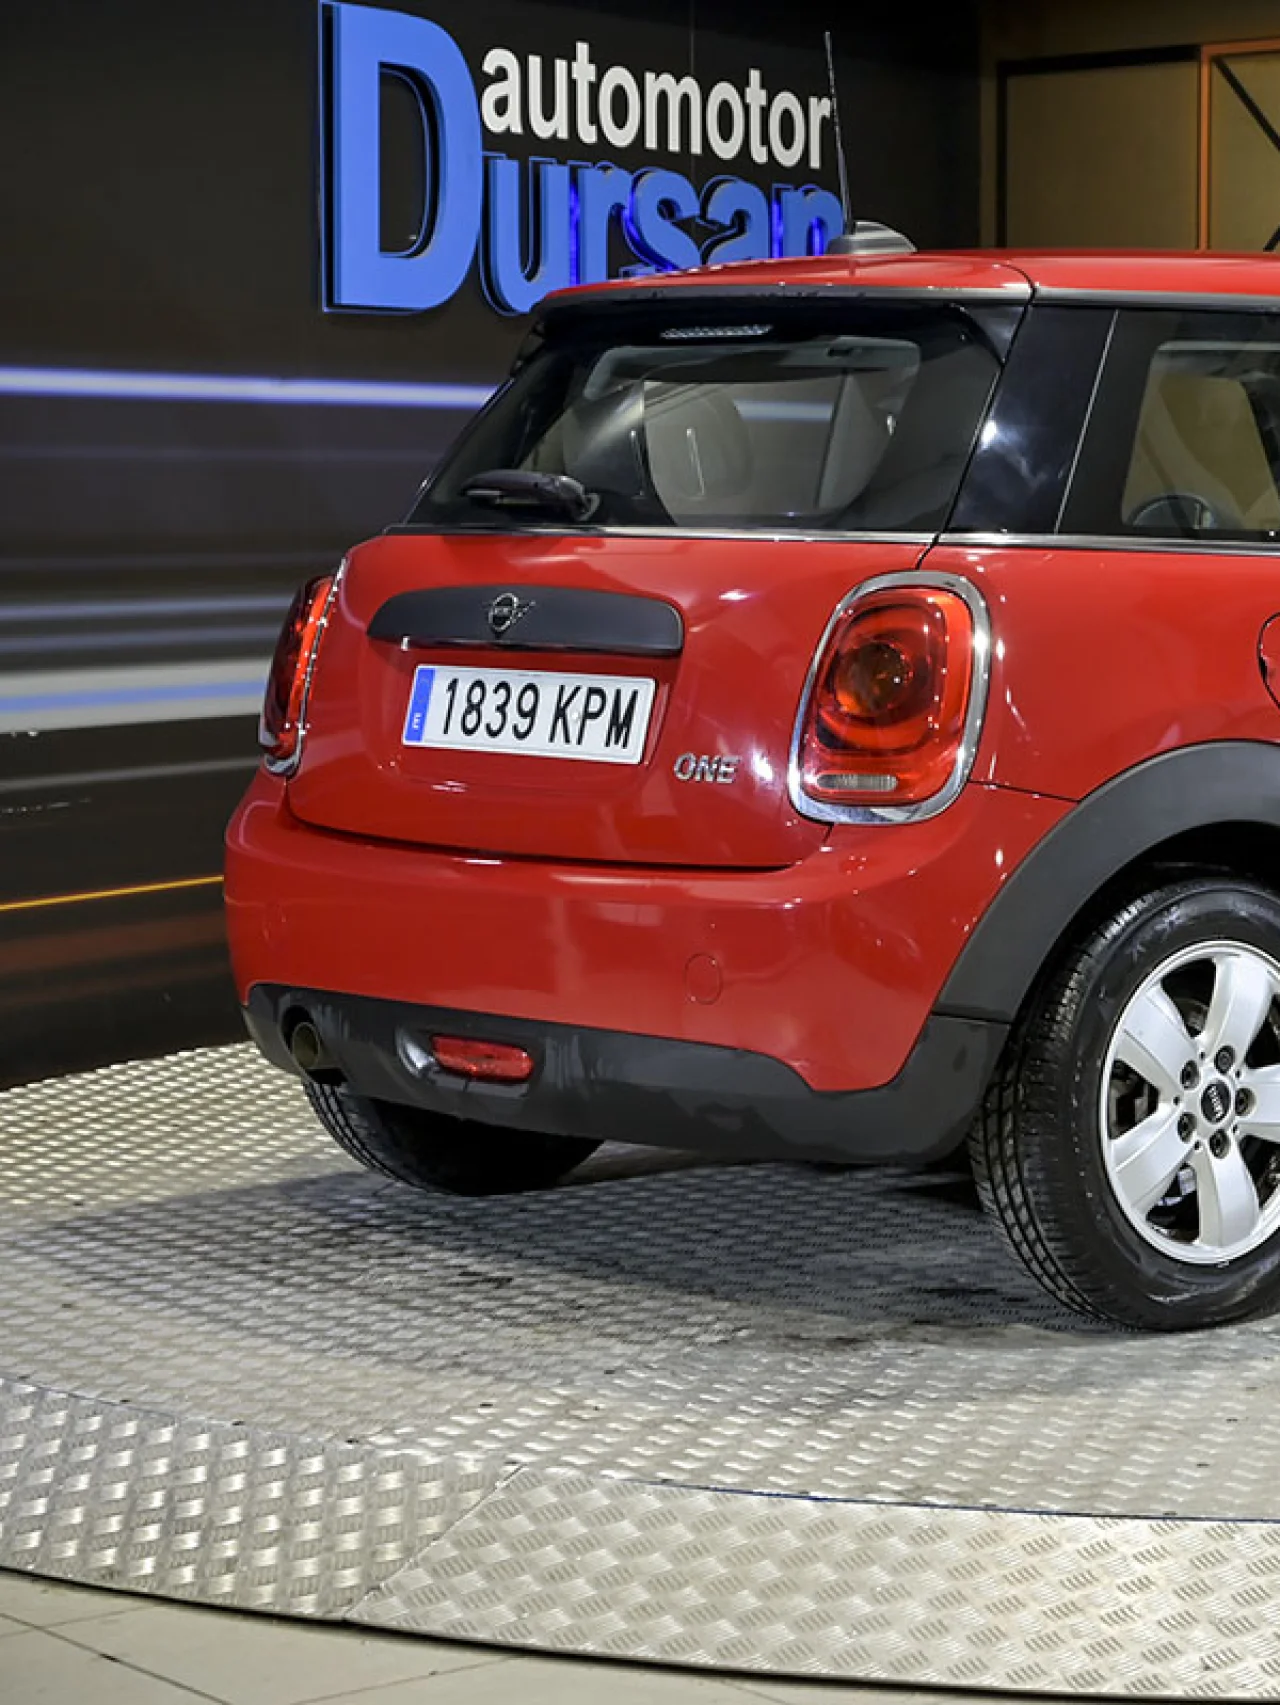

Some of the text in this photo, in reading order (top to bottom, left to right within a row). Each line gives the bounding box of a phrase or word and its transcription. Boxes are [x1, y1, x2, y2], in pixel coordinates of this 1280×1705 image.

[481, 42, 833, 169] automotor
[319, 0, 844, 316] Dursan
[412, 712, 422, 731] E
[442, 677, 639, 750] 1839 KPM
[673, 752, 741, 784] ONE
